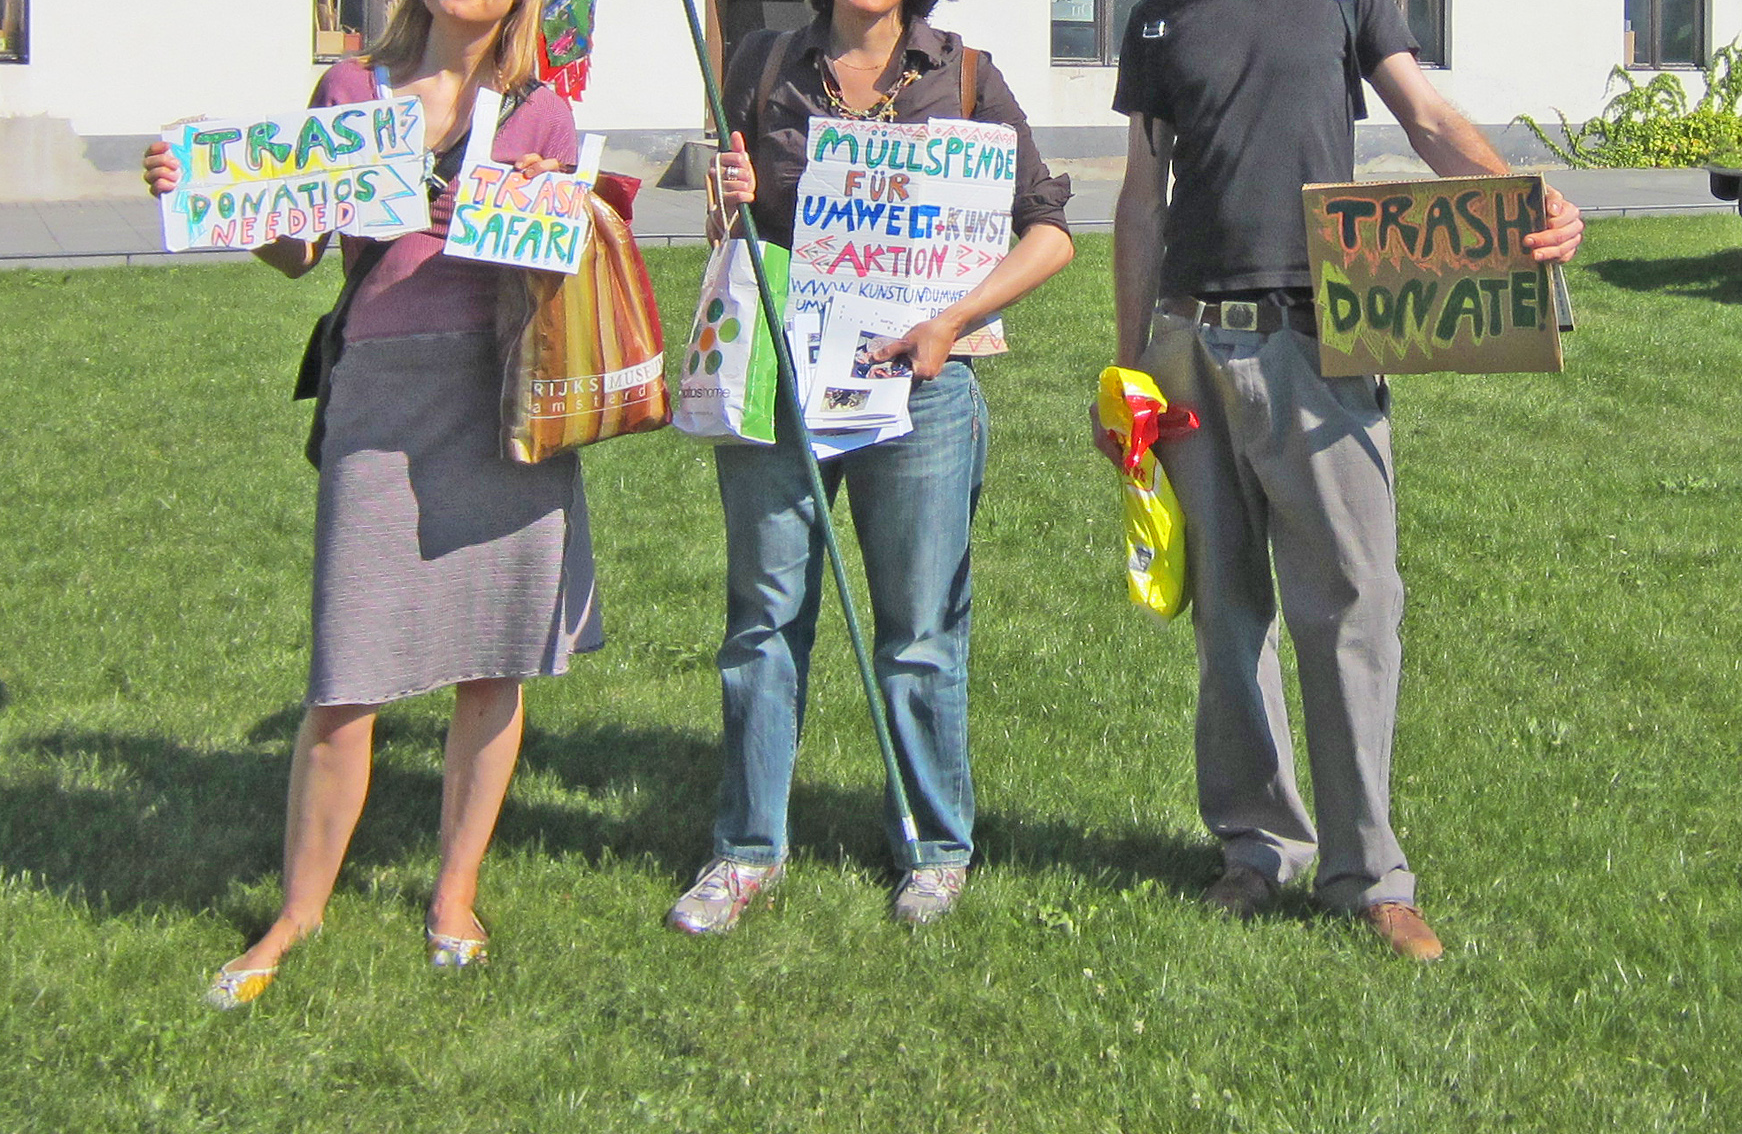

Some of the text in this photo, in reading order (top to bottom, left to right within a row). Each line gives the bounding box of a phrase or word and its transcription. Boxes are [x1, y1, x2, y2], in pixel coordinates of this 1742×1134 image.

[194, 107, 398, 173] TRASH
[813, 126, 1016, 180] MÜLLSPENDE
[470, 165, 588, 220] TRASH
[844, 170, 910, 203] FÜR
[210, 201, 356, 247] NEEDED
[449, 205, 579, 264] SAFARI
[1325, 189, 1532, 259] TRASH
[826, 241, 949, 279] AKTION
[858, 281, 969, 304] KUNSTUNDUMWE
